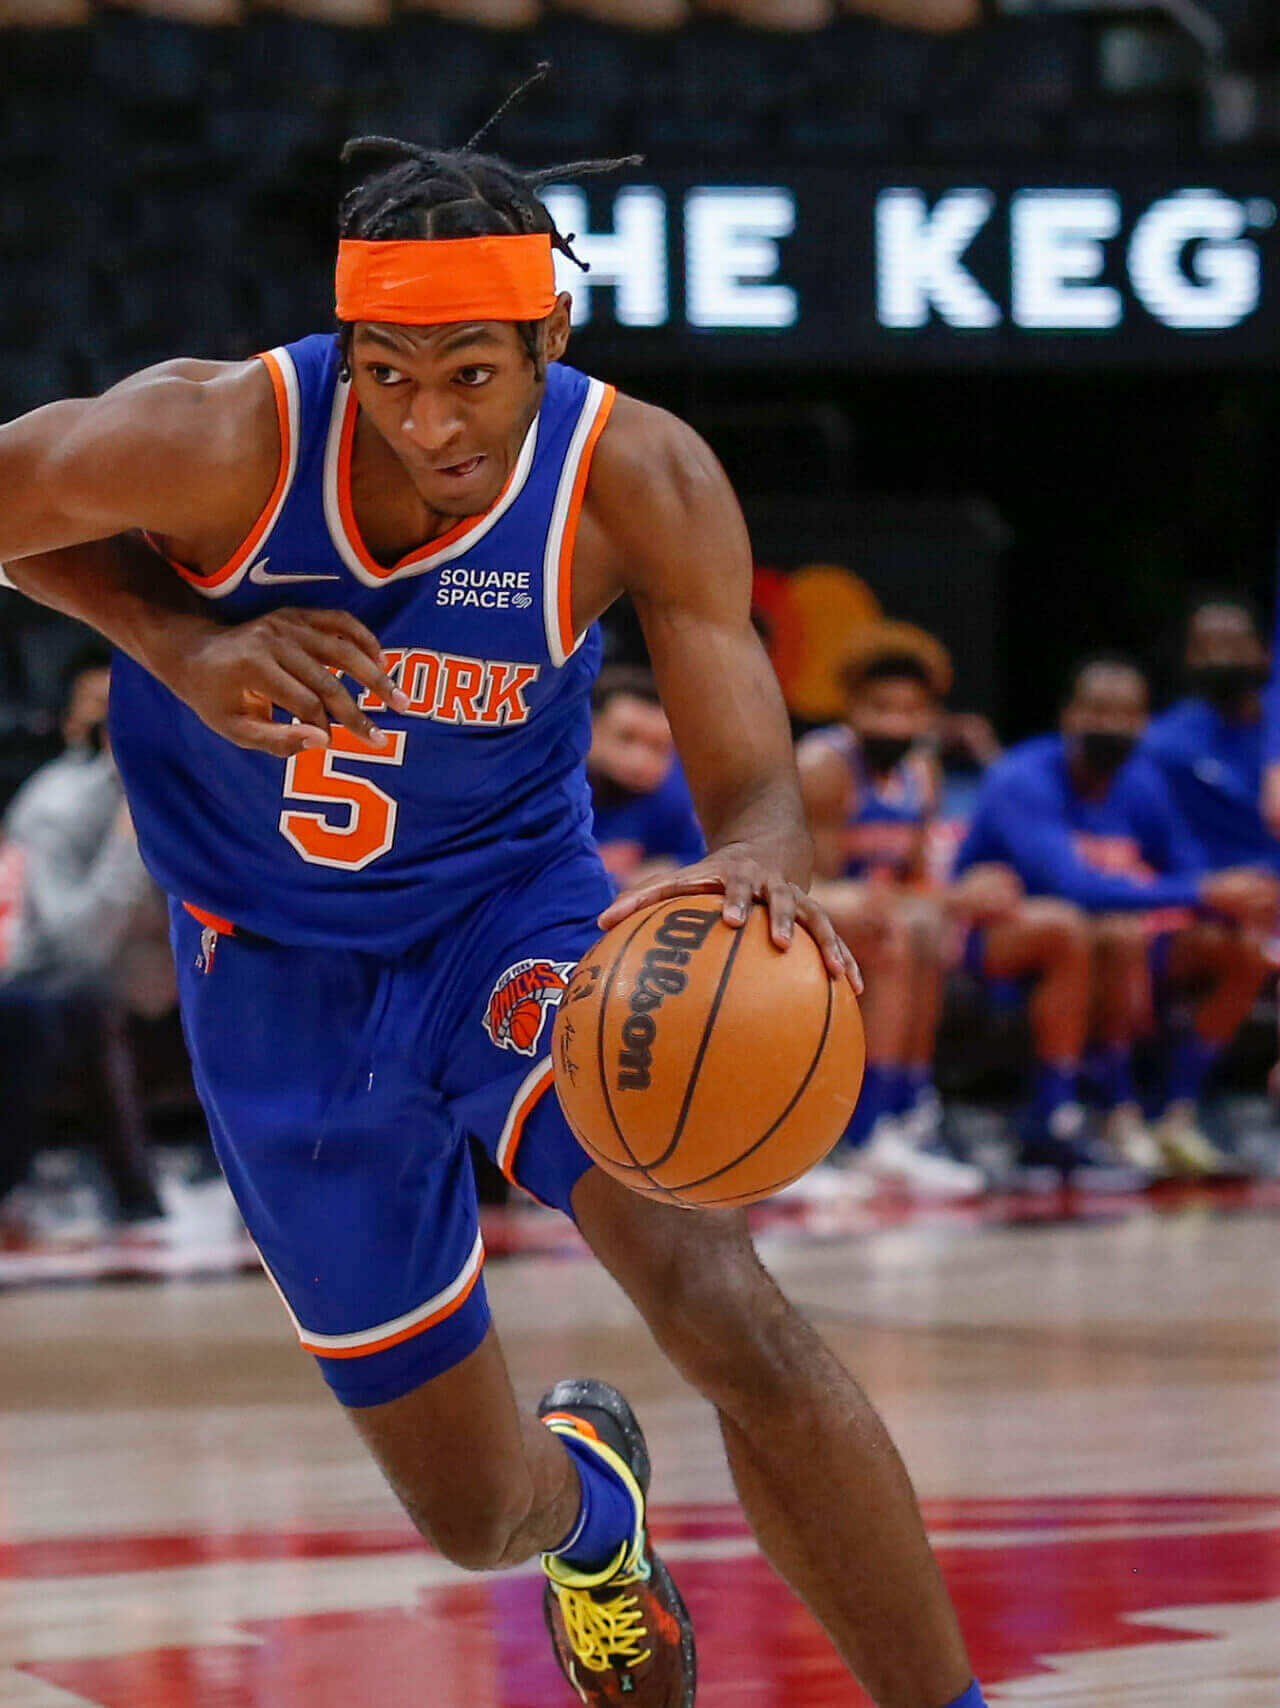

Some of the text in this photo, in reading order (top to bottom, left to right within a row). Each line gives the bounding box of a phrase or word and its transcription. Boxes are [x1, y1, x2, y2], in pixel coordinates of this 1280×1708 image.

[539, 185, 1262, 329] HE KEG
[436, 588, 510, 608] SPACE
[439, 568, 531, 589] SQUARE
[278, 716, 407, 872] 5
[617, 908, 719, 1092] Wilson
